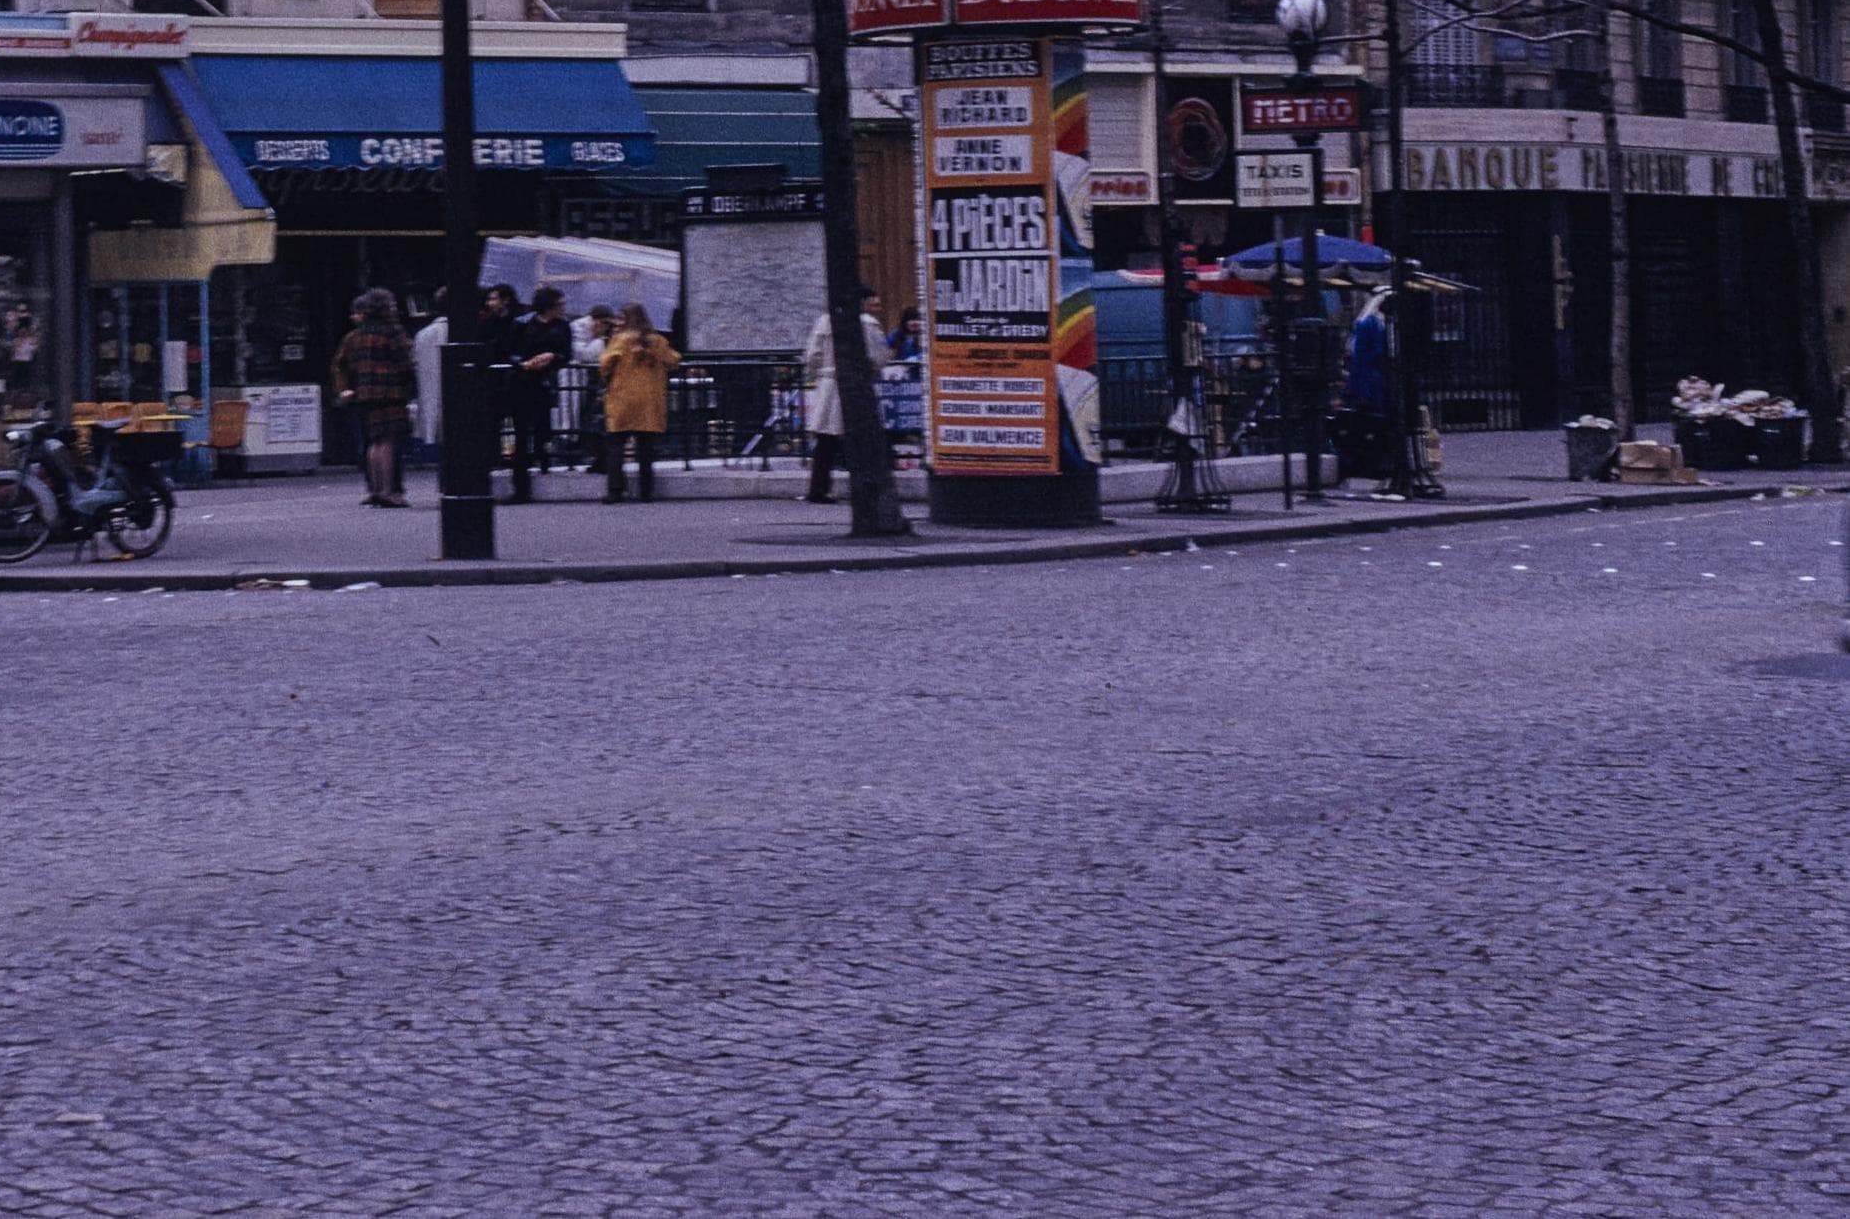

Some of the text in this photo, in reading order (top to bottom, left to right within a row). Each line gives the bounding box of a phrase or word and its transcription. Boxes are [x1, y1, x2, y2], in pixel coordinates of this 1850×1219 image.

[930, 43, 1032, 62] BOUFFES
[929, 60, 1039, 79] PARISIENS
[958, 90, 1008, 105] JEAN
[941, 107, 1027, 122] RICHARD
[1252, 98, 1353, 124] METRO
[360, 138, 544, 165] CONFERIE
[955, 140, 1002, 154] ANNE
[940, 157, 1022, 171] VERNON
[1245, 165, 1303, 178] TAXIS
[1407, 146, 1559, 190] BANQUE
[931, 199, 949, 251] 4
